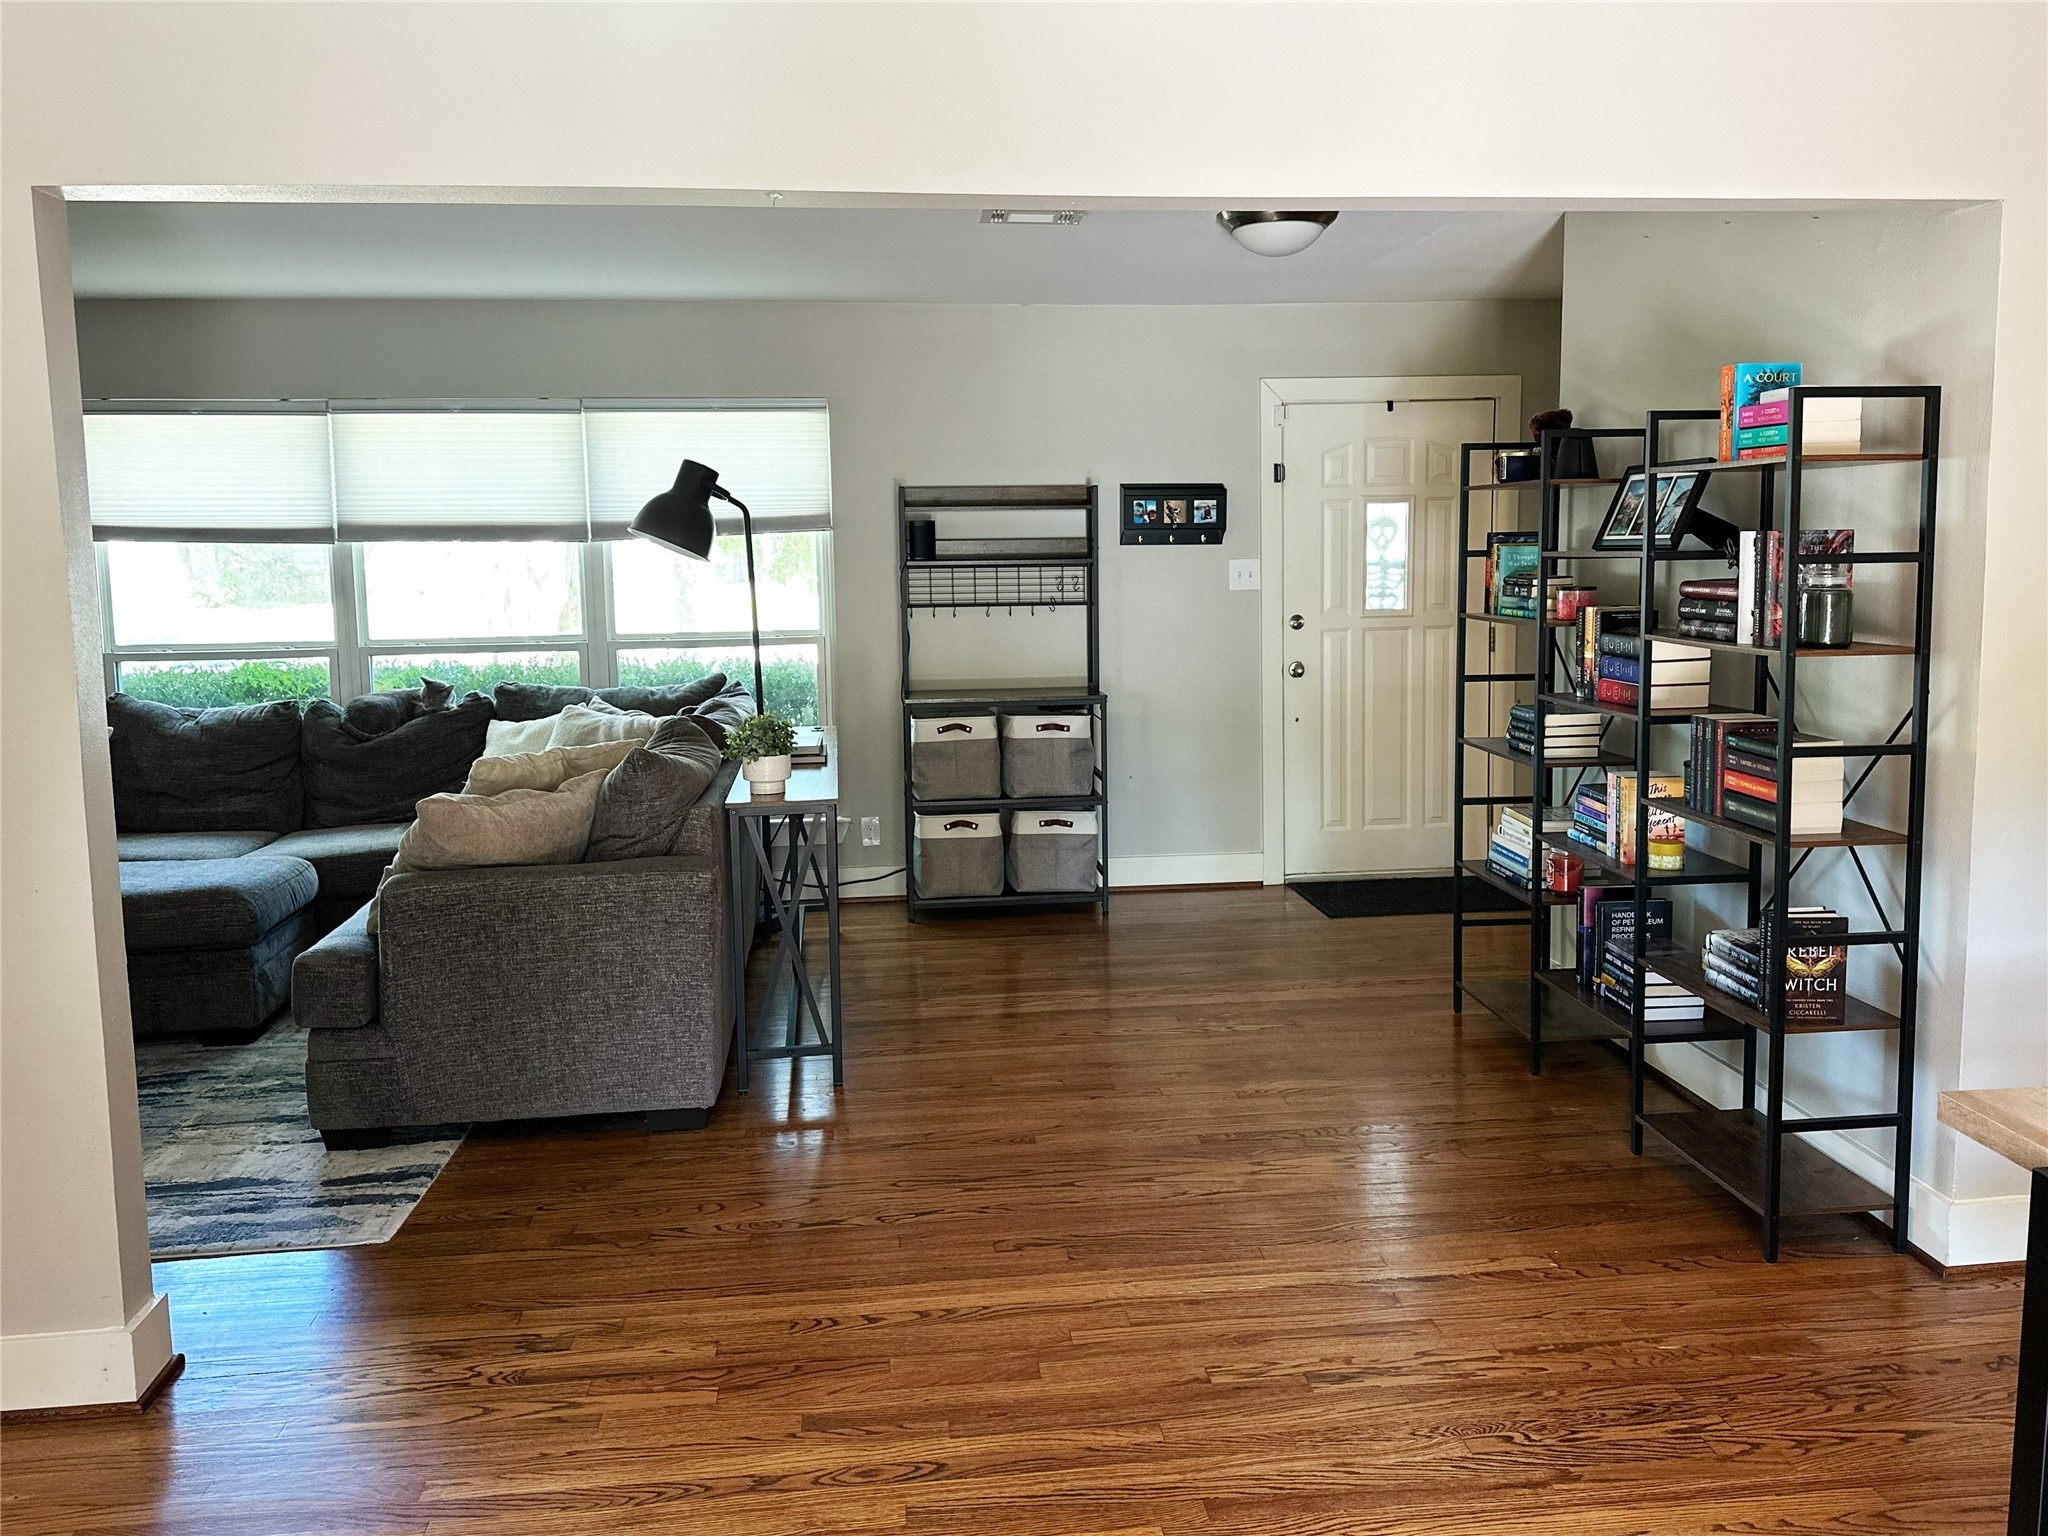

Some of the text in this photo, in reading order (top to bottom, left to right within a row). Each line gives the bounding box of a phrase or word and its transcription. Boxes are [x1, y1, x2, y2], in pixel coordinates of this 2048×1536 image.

[1744, 372, 1798, 384] A COURT
[1650, 783, 1667, 795] This
[1788, 946, 1837, 958] REBEL
[1785, 978, 1837, 992] WITCH
